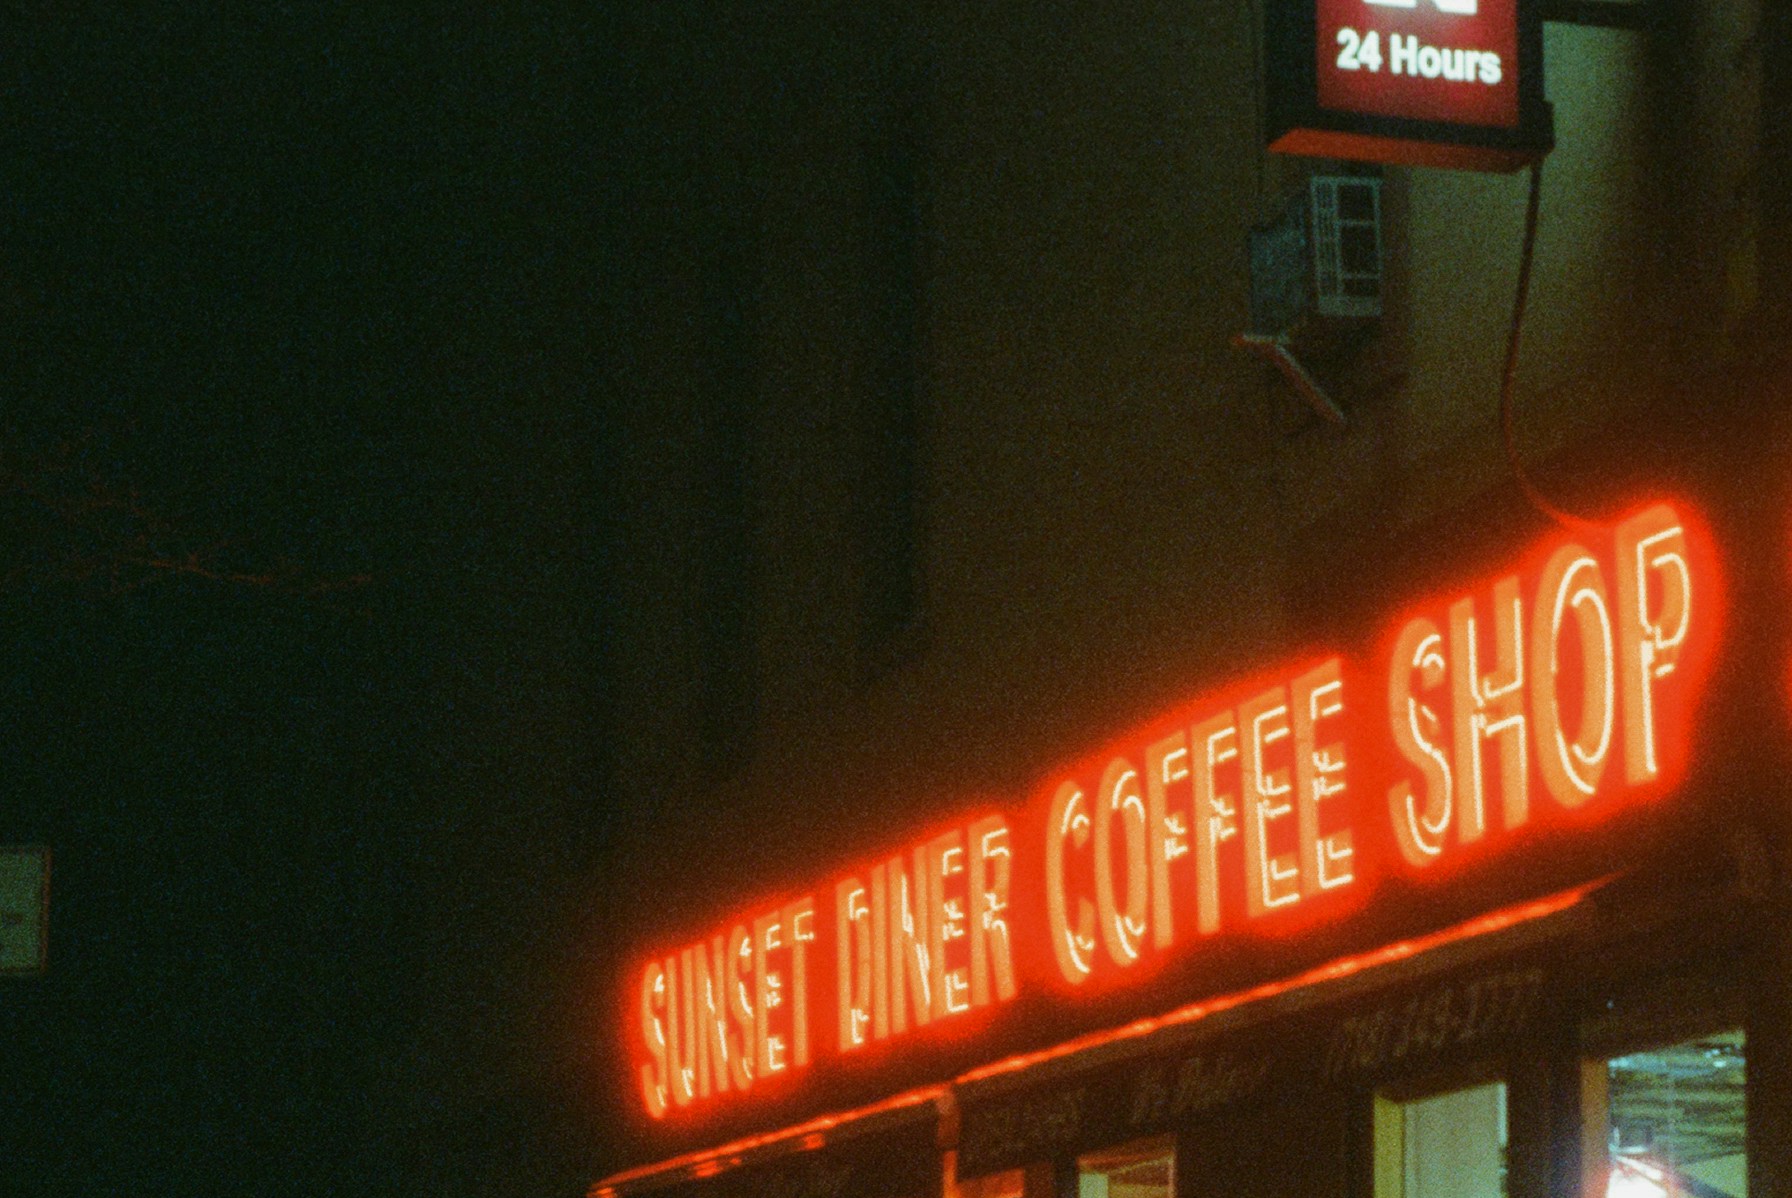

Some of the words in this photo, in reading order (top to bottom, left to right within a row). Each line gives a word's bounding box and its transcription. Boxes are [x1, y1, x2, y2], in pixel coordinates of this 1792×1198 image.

[1336, 27, 1382, 72] 24
[1389, 33, 1502, 84] Hours
[641, 896, 814, 1119] SUNSET
[836, 813, 1017, 1053] DINER
[1046, 657, 1353, 984] COFFEE
[1388, 503, 1691, 868] SHOP
